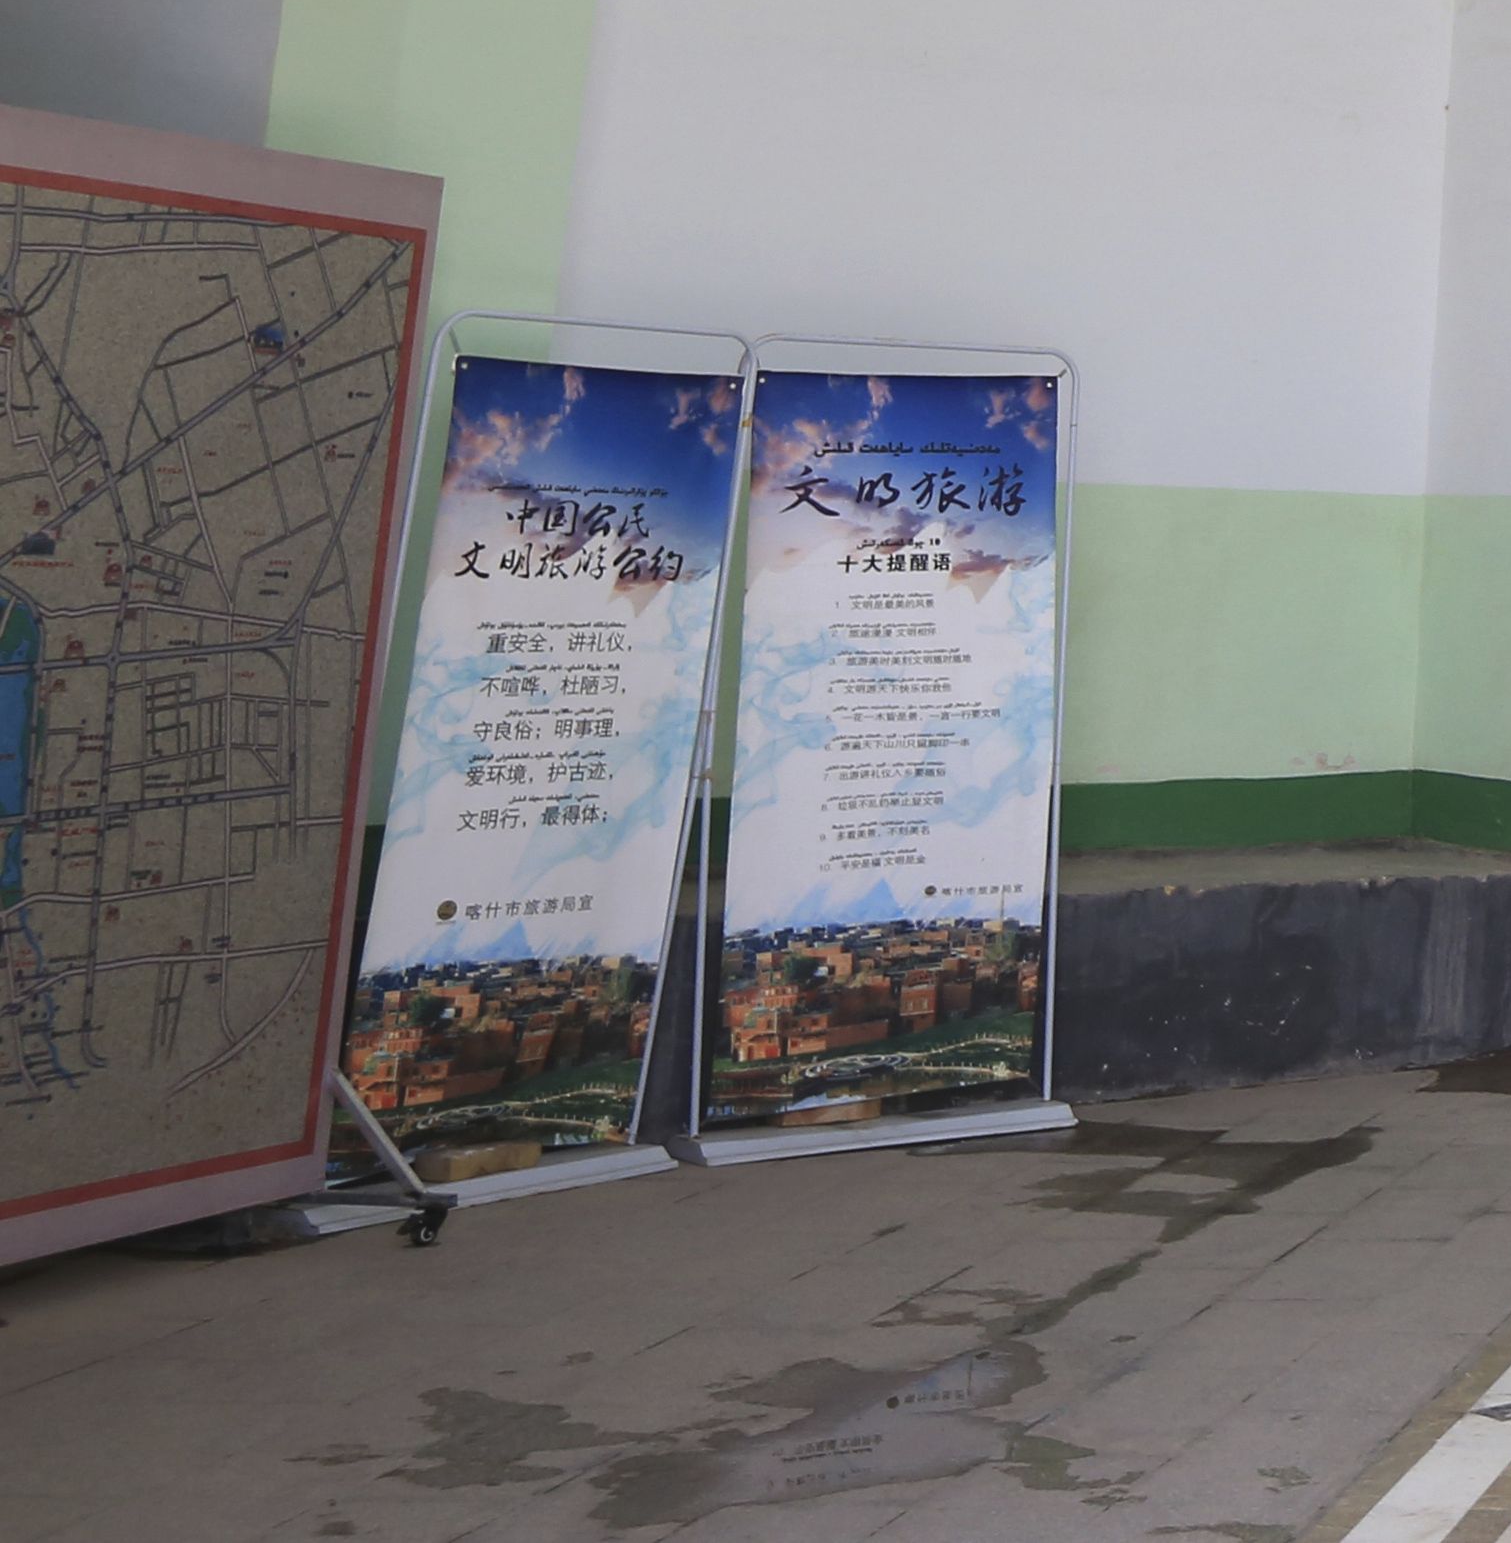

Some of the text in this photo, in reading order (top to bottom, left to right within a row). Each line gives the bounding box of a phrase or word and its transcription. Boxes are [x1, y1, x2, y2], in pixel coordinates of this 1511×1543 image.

[780, 462, 1028, 518] 文明旅游
[505, 499, 651, 537] 中国公民
[454, 540, 684, 582] 文明旅游公约
[836, 553, 952, 574] 十大提醒语
